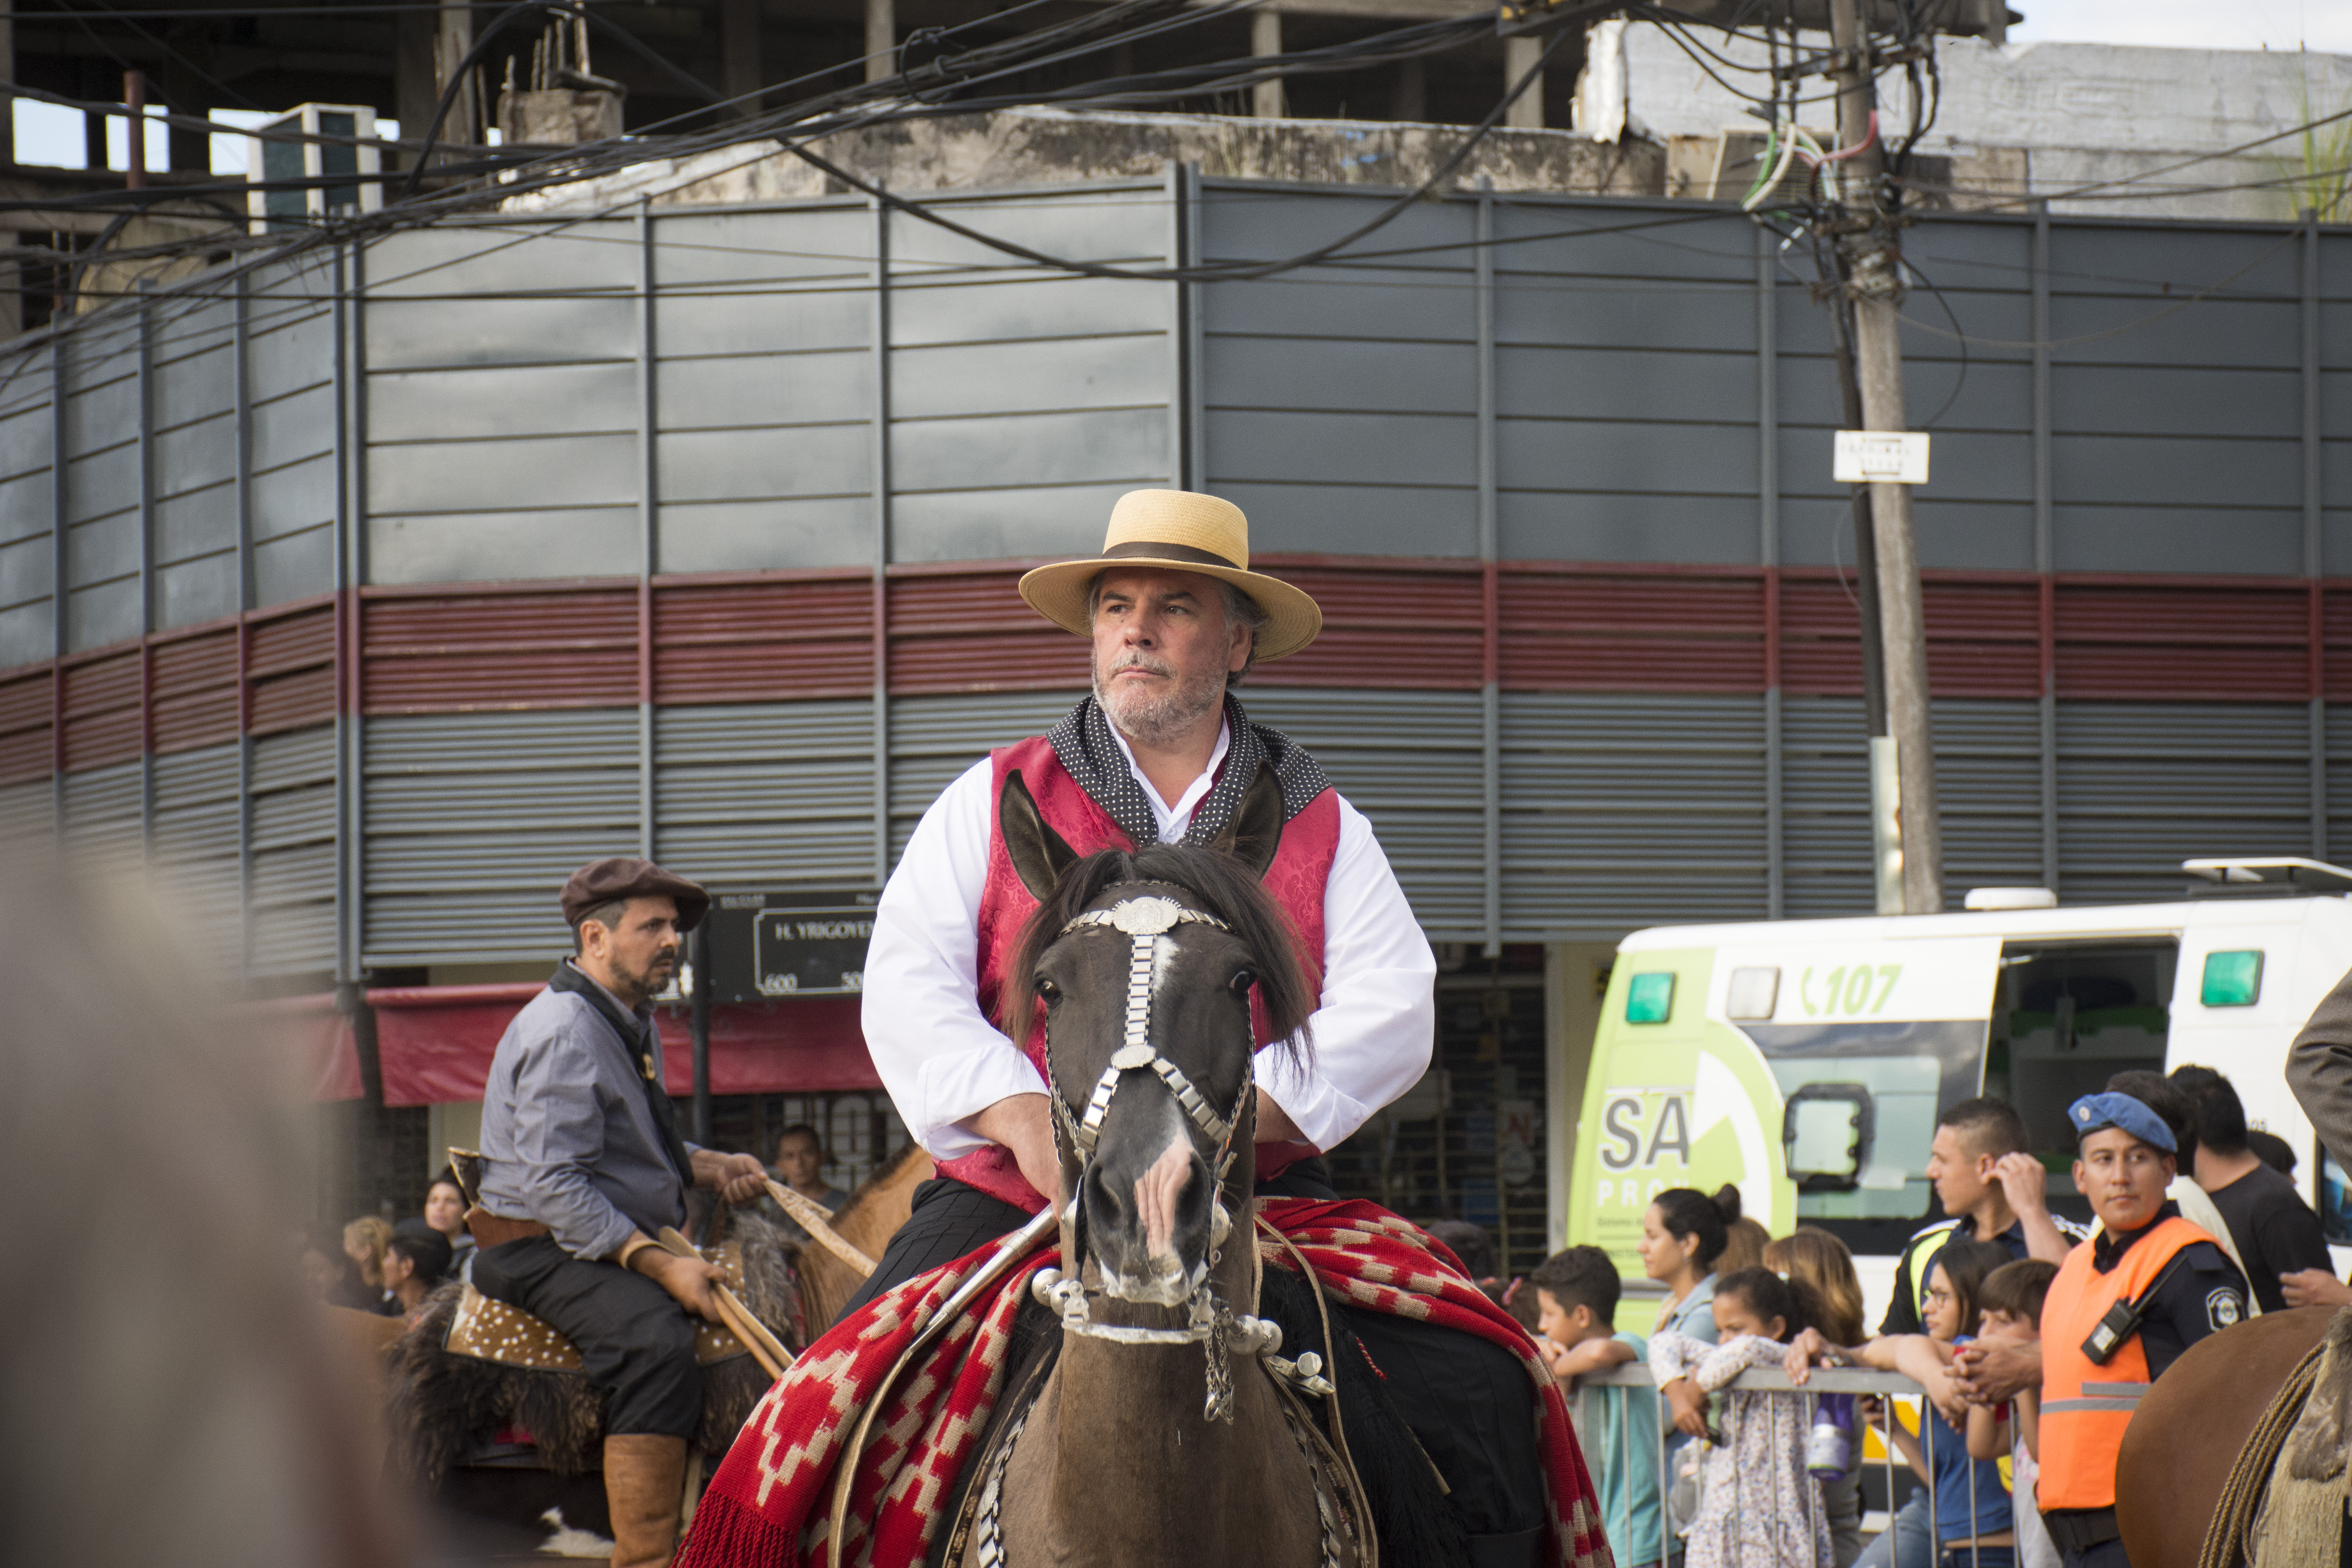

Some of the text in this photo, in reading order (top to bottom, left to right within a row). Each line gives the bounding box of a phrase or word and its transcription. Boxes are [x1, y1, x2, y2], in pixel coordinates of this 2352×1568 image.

[775, 923, 794, 940] H.
[765, 971, 864, 993] 600 50
[1824, 963, 1902, 1014] 107
